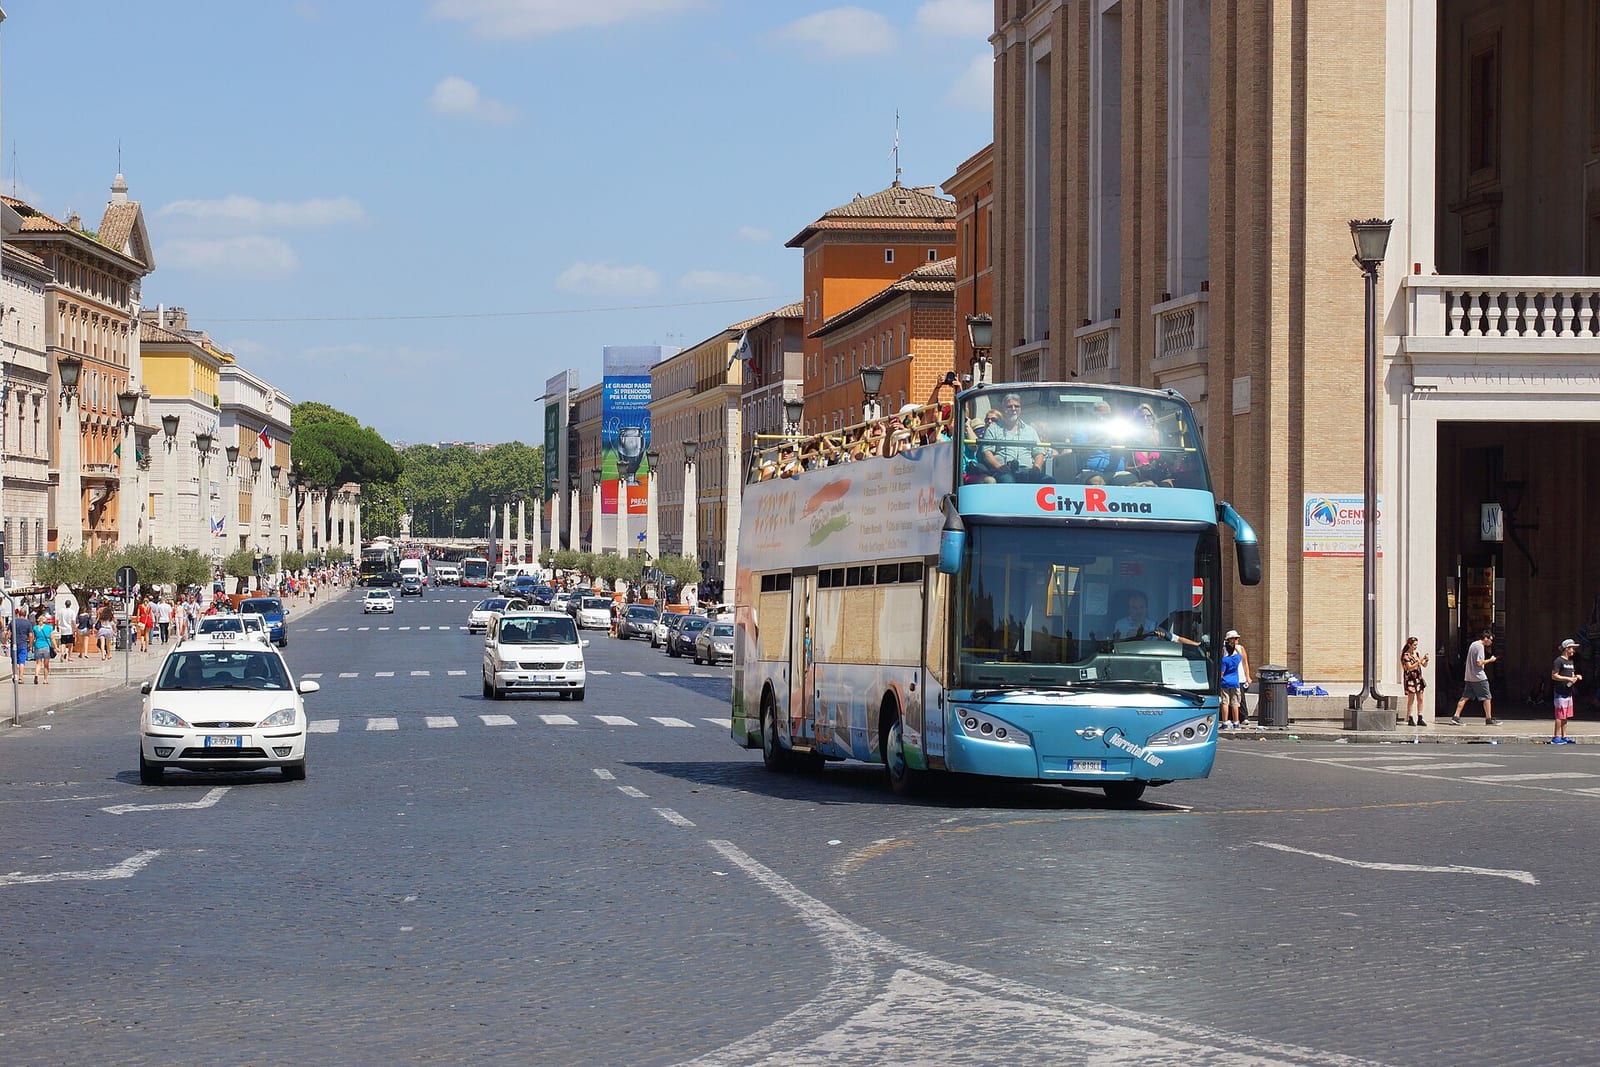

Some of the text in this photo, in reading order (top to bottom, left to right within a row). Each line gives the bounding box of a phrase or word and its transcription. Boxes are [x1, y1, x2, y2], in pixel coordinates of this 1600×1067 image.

[1036, 486, 1152, 515] CityRoma
[1339, 510, 1381, 519] CENTO
[212, 632, 235, 640] TAXI
